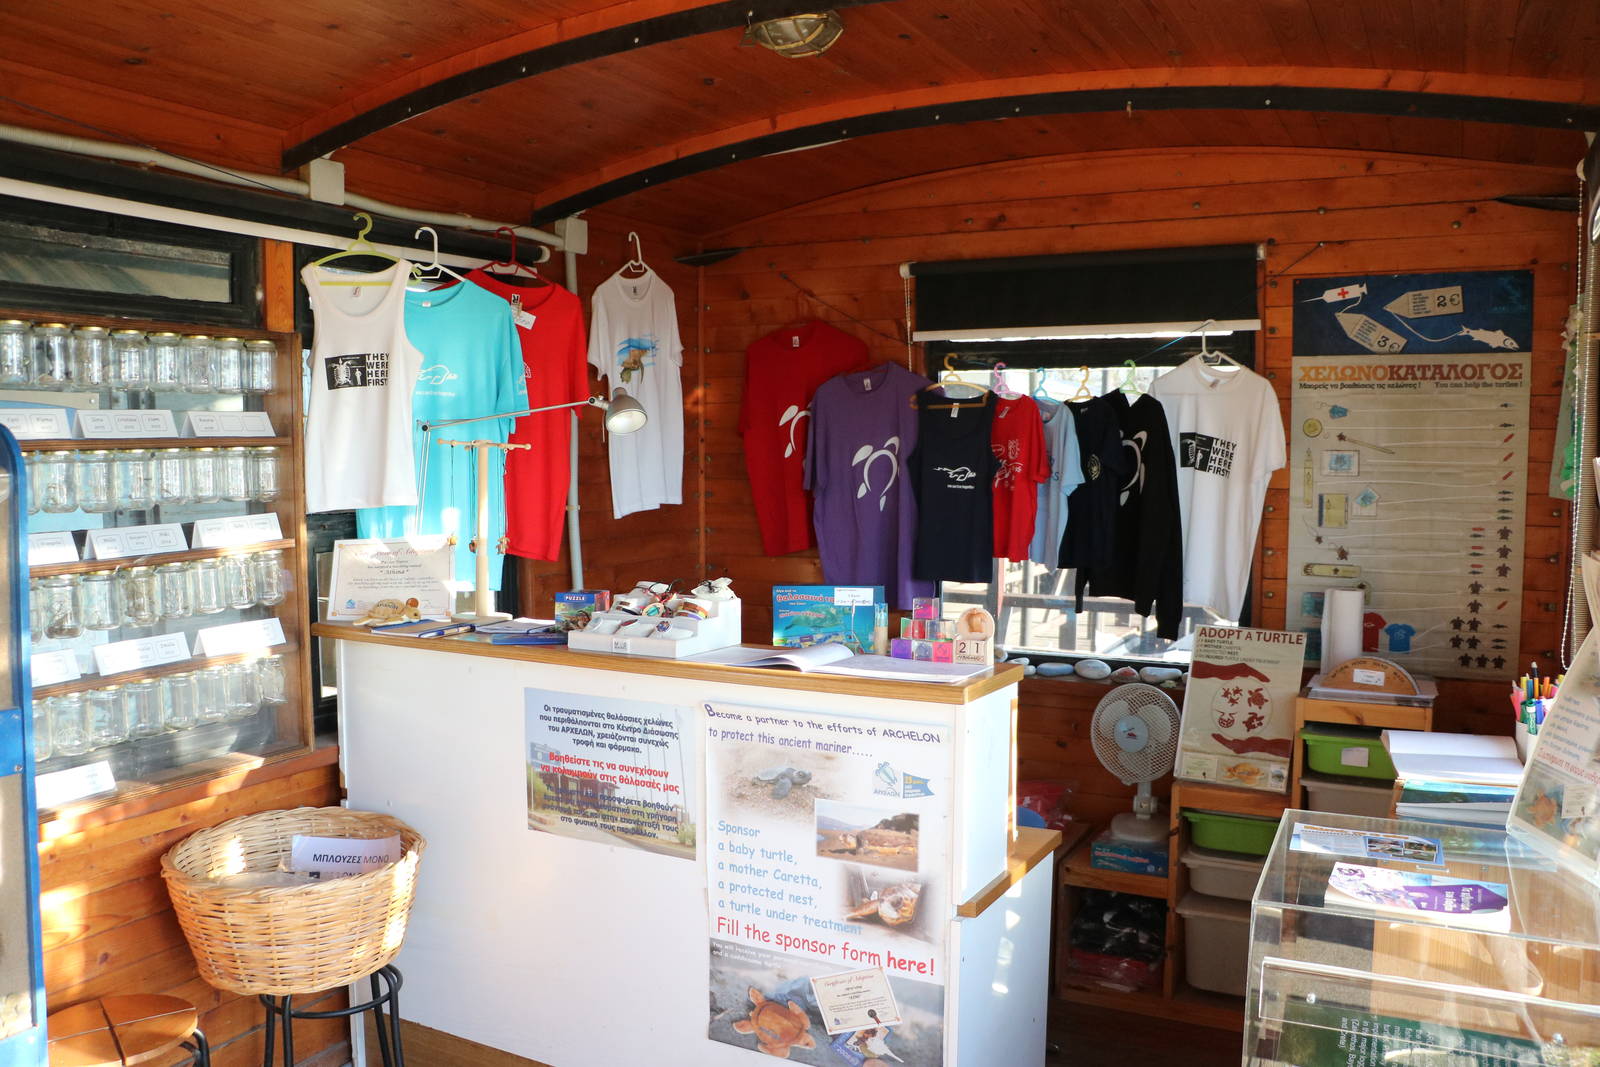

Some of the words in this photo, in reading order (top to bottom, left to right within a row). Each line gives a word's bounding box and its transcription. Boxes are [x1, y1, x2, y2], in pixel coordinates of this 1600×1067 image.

[1437, 295, 1447, 308] 2
[1377, 335, 1389, 348] 3
[366, 353, 389, 361] THEY
[366, 361, 389, 370] WERE
[367, 370, 389, 378] HERE
[1298, 363, 1523, 382] ΧΕΛΩΝΟΚΑΤΑΛΟΓΟΣ
[1212, 438, 1237, 452] THEY
[1212, 446, 1234, 460] WERE
[1210, 456, 1232, 470] HERE
[1200, 627, 1242, 640] ADOPT
[1245, 631, 1253, 641] A
[1256, 632, 1304, 645] TURTLE
[544, 704, 551, 712] Οι
[552, 706, 606, 720] τραυματισμένες
[606, 712, 642, 724] θαλάσσιες
[644, 717, 673, 729] χελώνες
[704, 704, 743, 720] Become
[755, 716, 790, 726] partner
[793, 719, 804, 728] to
[807, 720, 824, 730] the
[827, 722, 863, 735] efforts
[866, 727, 877, 736] of
[882, 729, 941, 744] ARCHELON
[540, 714, 552, 722] που
[553, 716, 600, 729] περιθάλπονται
[602, 722, 614, 730] στο
[616, 722, 642, 734] Κέντρο
[643, 727, 679, 740] Διάσωσης
[548, 724, 560, 732] του
[561, 726, 596, 738] ΑΡΧΕΛΩΝ,
[597, 731, 637, 744] χρειάζονται
[638, 736, 669, 749] συνεχώς
[572, 738, 594, 748] τροφή
[596, 740, 606, 748] και
[708, 727, 718, 738] to
[721, 729, 754, 742] protect
[758, 732, 775, 744] this
[778, 736, 812, 749] ancient
[549, 752, 590, 767] Βοηθείστε
[593, 760, 604, 770] τις
[606, 762, 617, 770] να
[619, 762, 669, 778] συνεχίσουν
[540, 764, 550, 772] να
[600, 773, 617, 784] στις
[662, 783, 680, 795] μας
[560, 816, 572, 824] στο
[574, 817, 598, 828] φυσικό
[600, 823, 616, 832] τους
[718, 820, 761, 837] Sponsor
[312, 854, 362, 864] ΜΠΛΟΥΖΕΣ
[364, 854, 390, 864] ΜΟΝΟ
[718, 842, 725, 850] a
[728, 840, 756, 860] baby
[760, 848, 798, 866] turtle,
[718, 862, 725, 870] a
[728, 862, 769, 878] mother
[773, 868, 823, 890] Caretta,
[718, 880, 725, 889] a
[728, 880, 784, 900] protected
[788, 892, 818, 909] nest,
[718, 900, 726, 908] a
[730, 900, 762, 916] turtle
[766, 907, 798, 922] under
[802, 914, 864, 936] treatment
[717, 916, 739, 936] Fill
[744, 924, 770, 944] the
[776, 932, 836, 956] sponsor
[842, 942, 881, 966] form
[887, 951, 935, 976] here!
